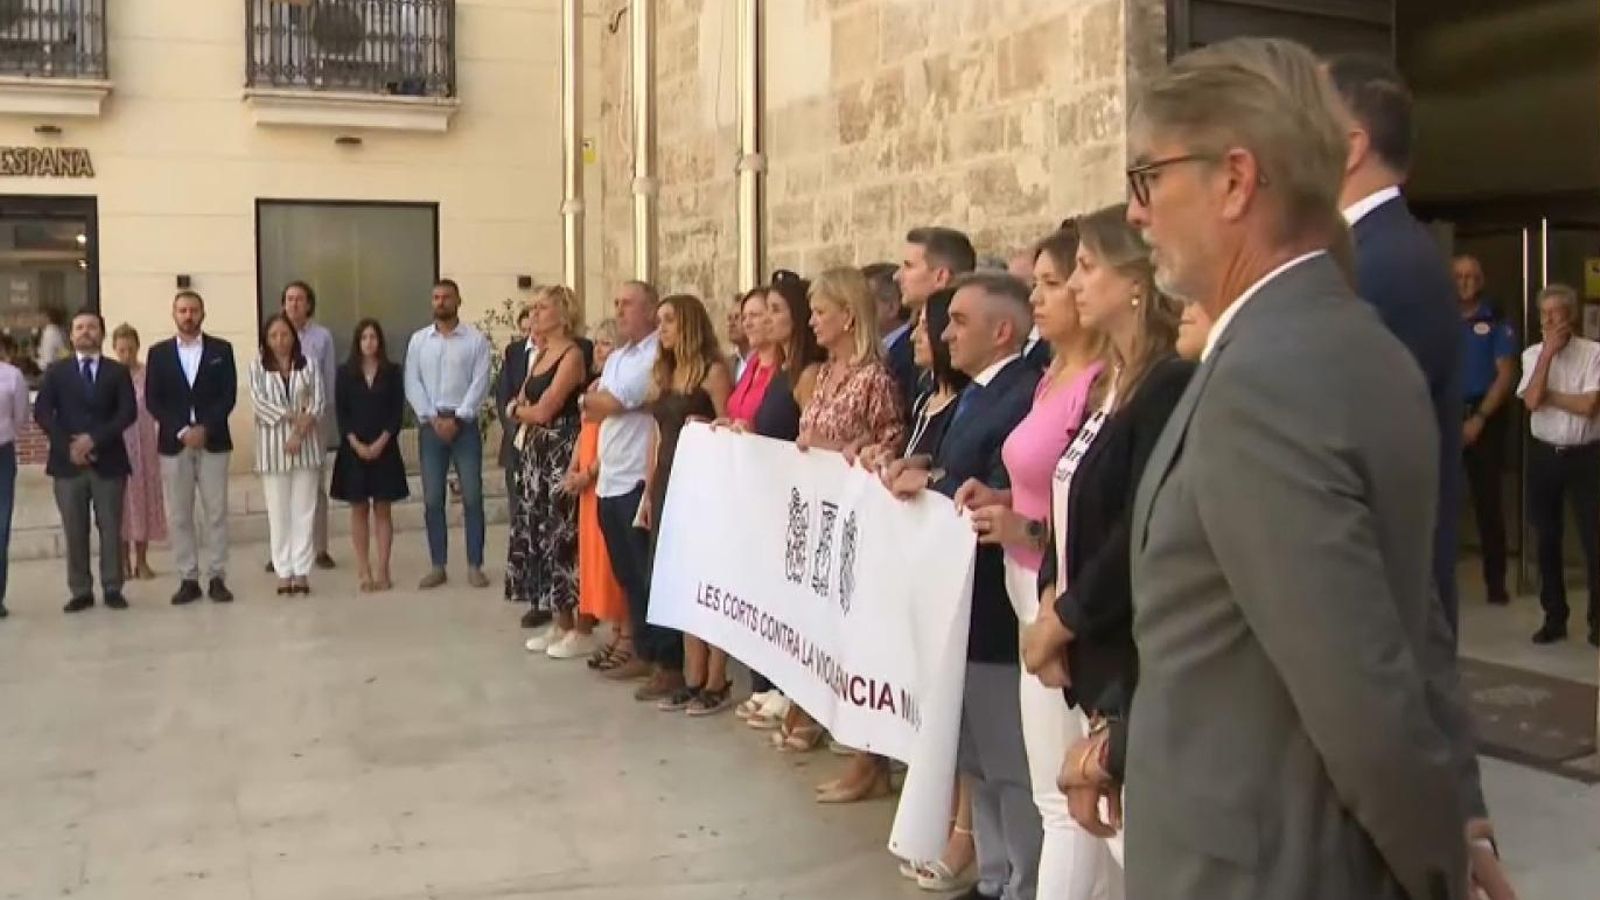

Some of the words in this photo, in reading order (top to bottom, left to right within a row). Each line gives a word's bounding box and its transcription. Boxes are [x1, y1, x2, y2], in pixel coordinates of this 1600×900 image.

[697, 582, 720, 611] LES
[723, 593, 759, 632] CORTS
[760, 613, 800, 660] CONTRA
[801, 638, 813, 670] LA
